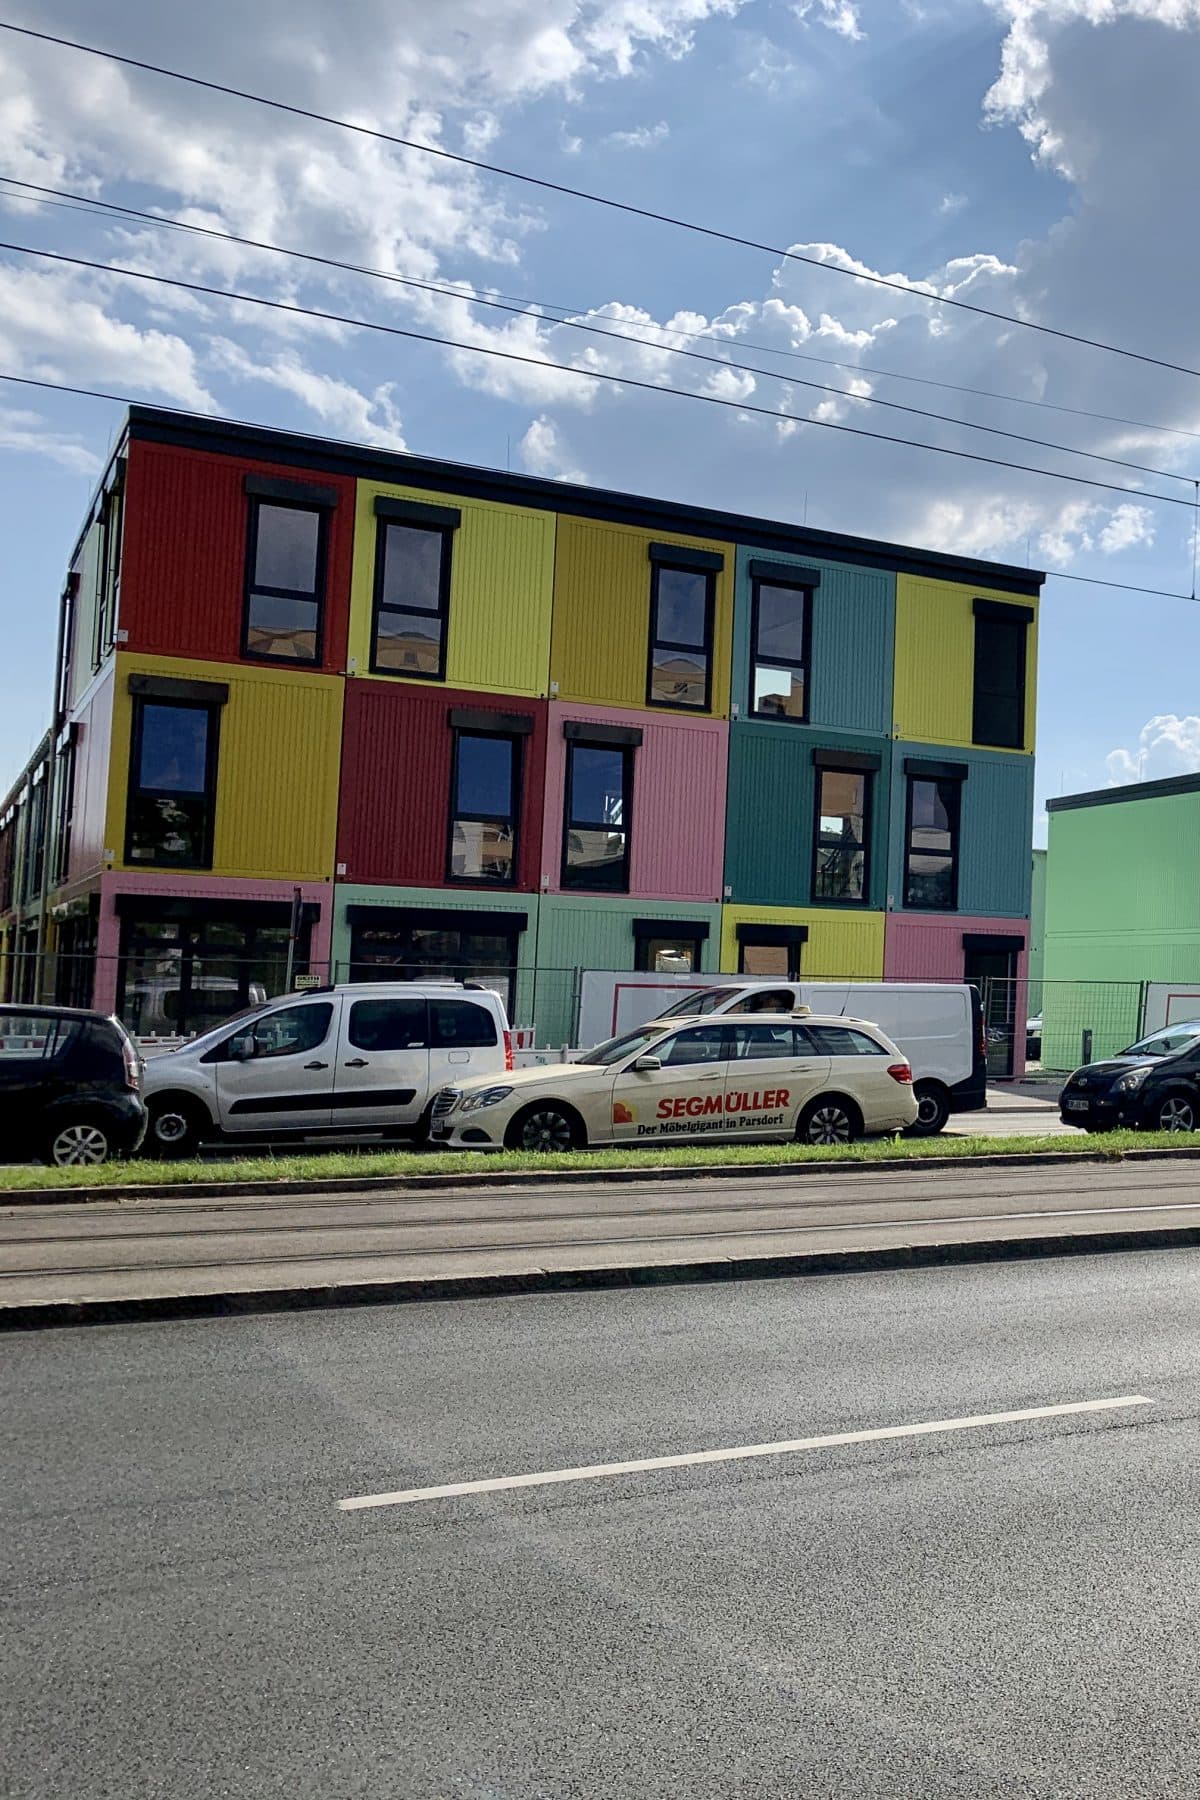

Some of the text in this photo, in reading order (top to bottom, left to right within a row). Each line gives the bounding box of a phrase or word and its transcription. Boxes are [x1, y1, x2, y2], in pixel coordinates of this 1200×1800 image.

[656, 1089, 790, 1119] SEGMÜLLER
[637, 1113, 784, 1135] Der Möbelgigant in Parsdorf
